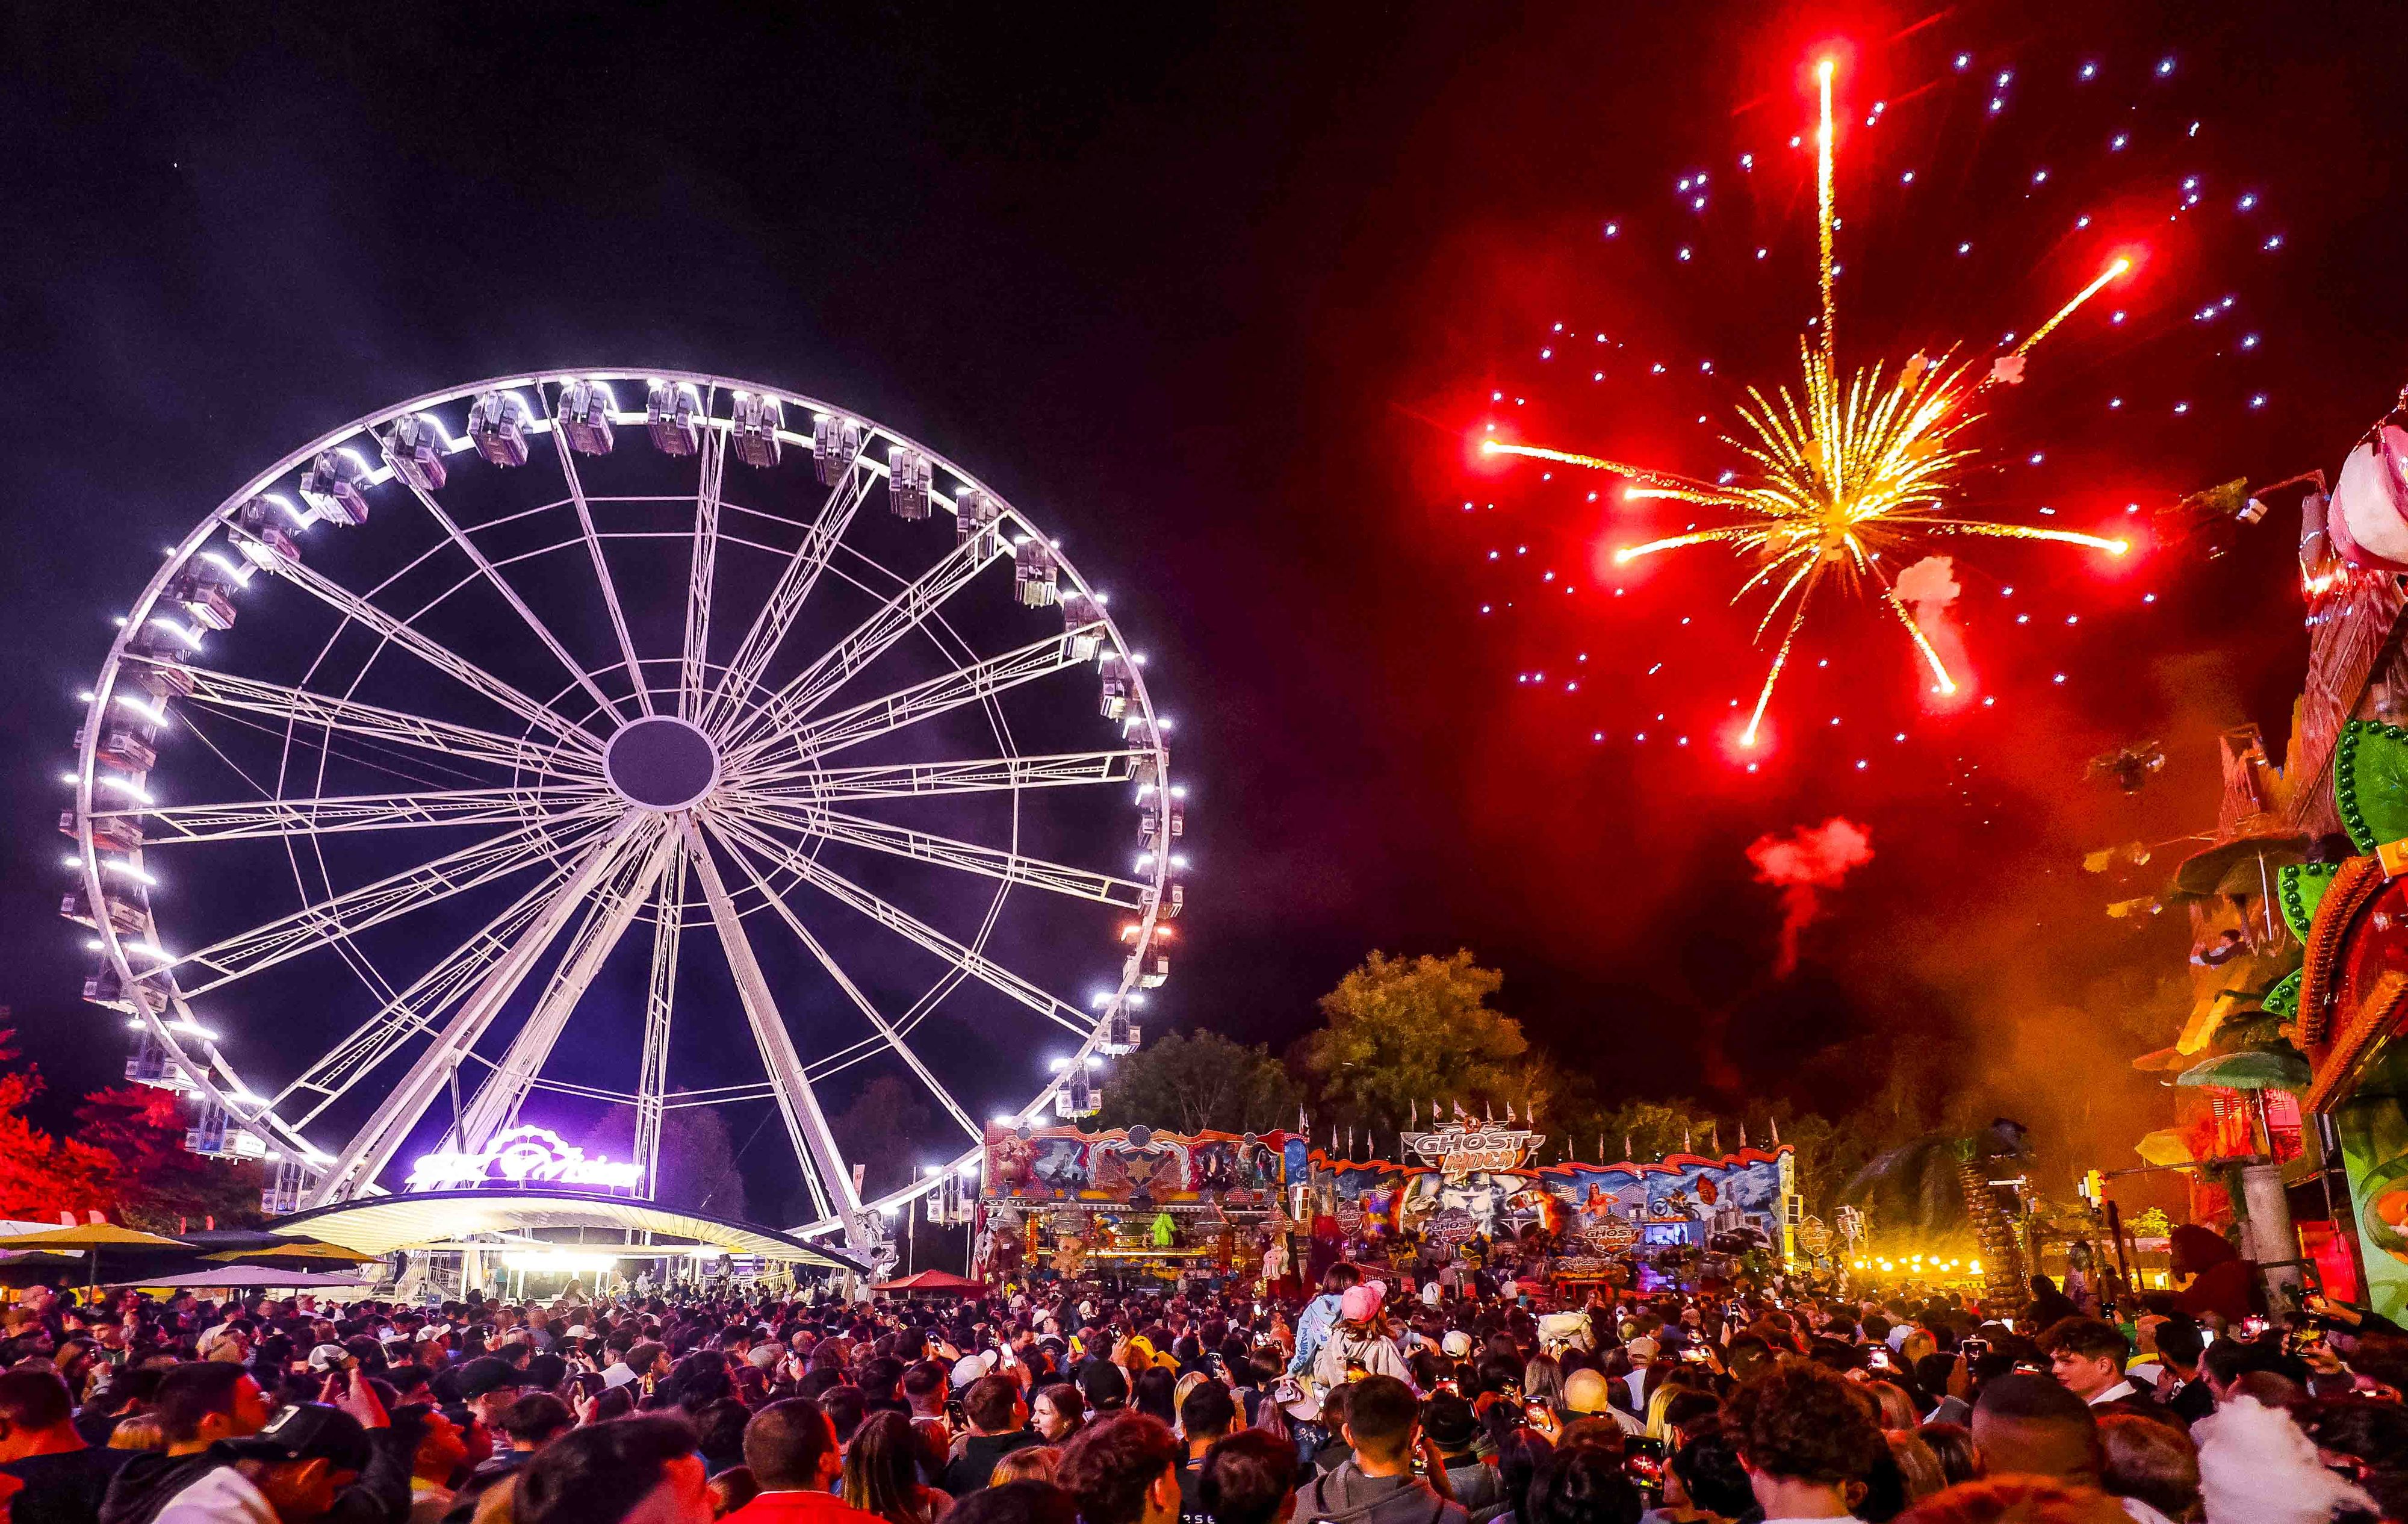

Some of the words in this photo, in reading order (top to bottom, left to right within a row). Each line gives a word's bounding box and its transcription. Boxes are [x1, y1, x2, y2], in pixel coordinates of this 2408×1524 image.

[1415, 1131, 1530, 1152] GHOST
[1444, 1150, 1515, 1175] RIDER
[1432, 1220, 1477, 1230] GHOST
[1586, 1229, 1637, 1237] GHOST
